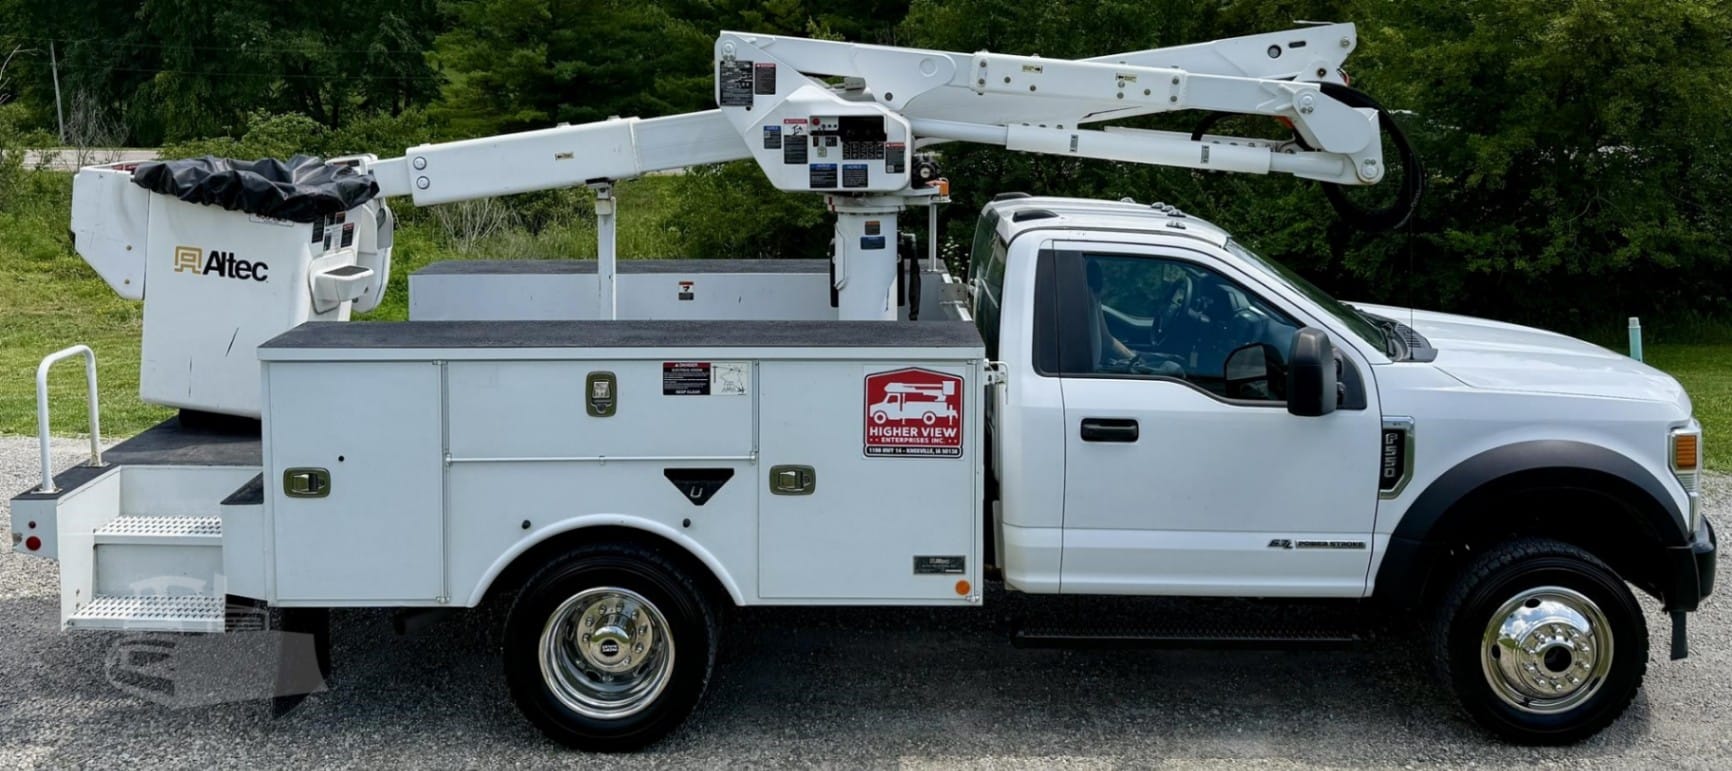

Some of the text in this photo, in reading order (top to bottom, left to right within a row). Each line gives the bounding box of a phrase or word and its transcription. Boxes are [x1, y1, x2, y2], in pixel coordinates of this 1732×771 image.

[202, 250, 269, 282] Altec
[870, 427, 957, 437] HIGHER VIEW
